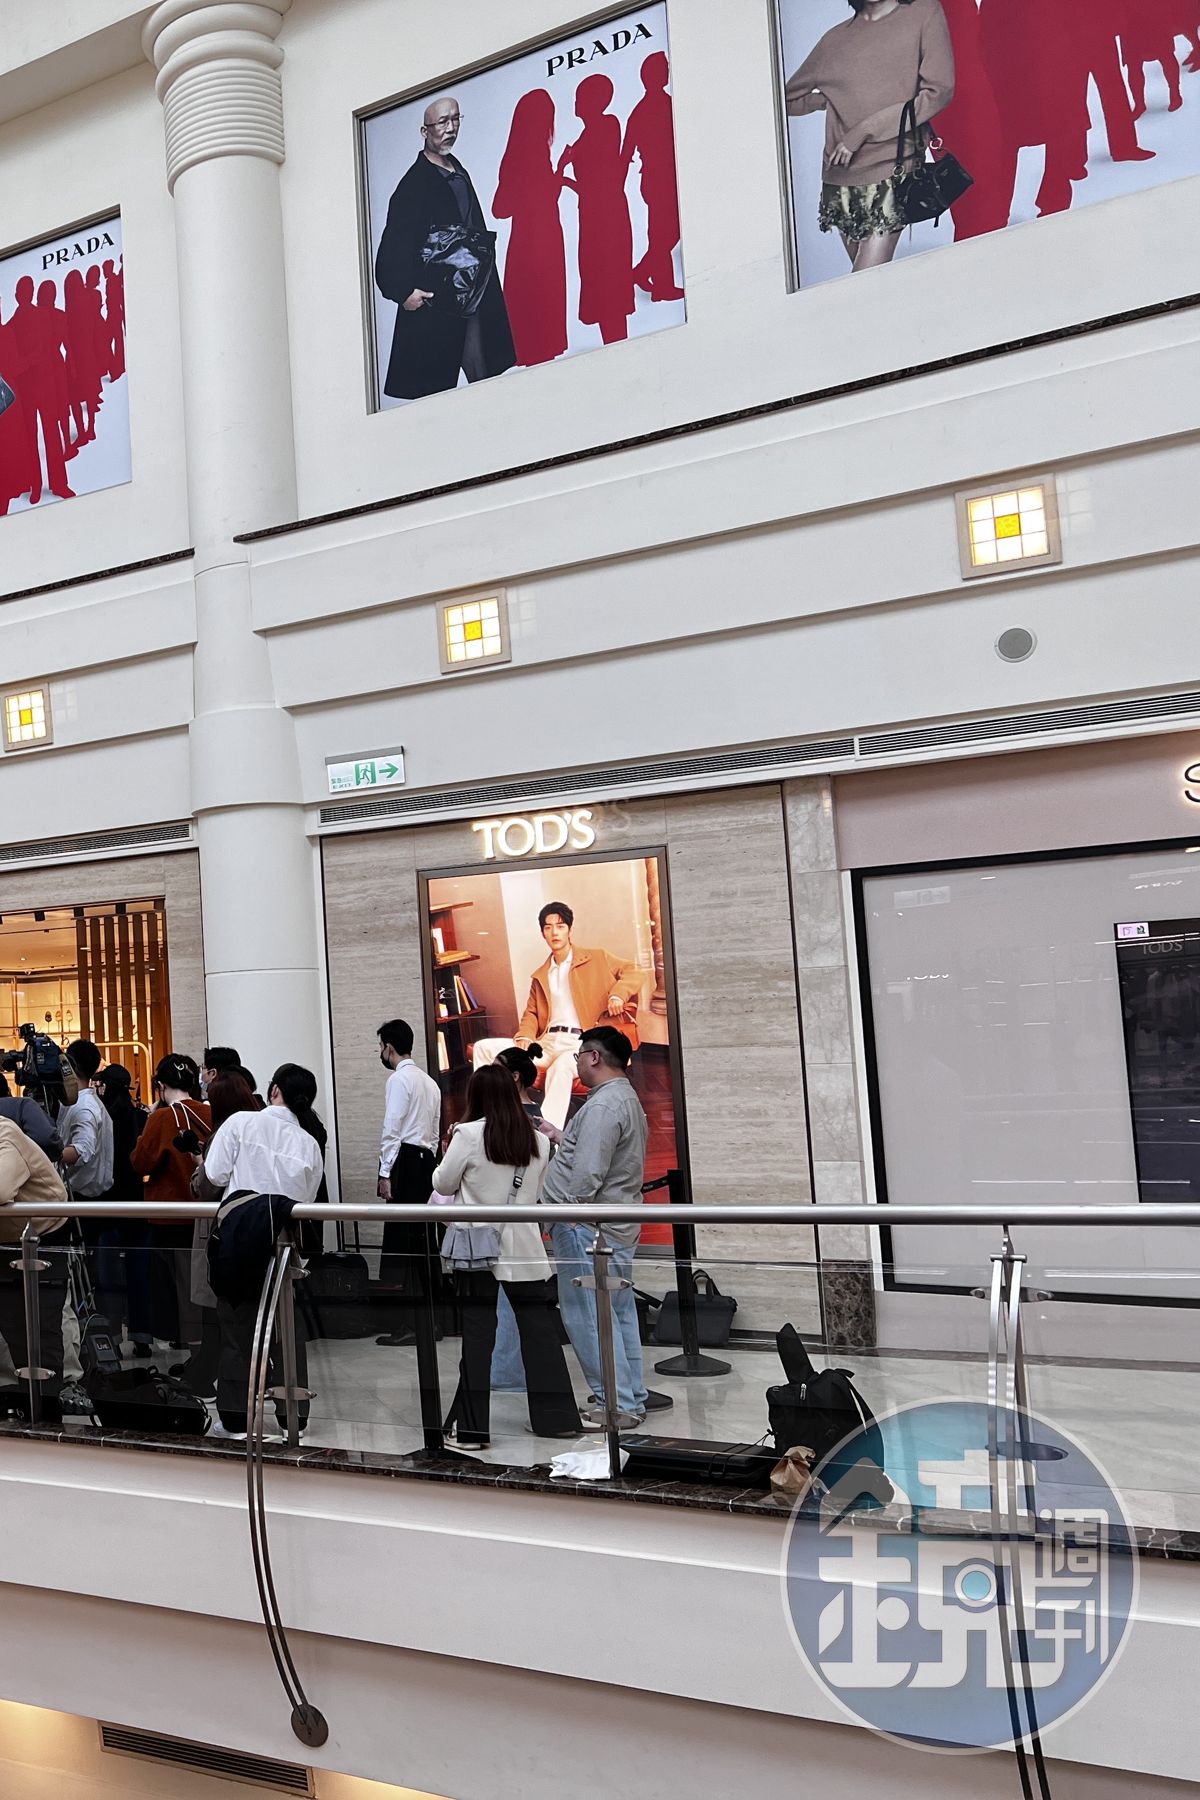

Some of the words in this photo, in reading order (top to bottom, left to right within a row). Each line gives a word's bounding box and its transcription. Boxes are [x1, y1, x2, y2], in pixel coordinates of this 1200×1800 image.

[546, 23, 653, 77] PRADA
[42, 232, 114, 270] PRADA
[472, 809, 596, 859] TOD'S
